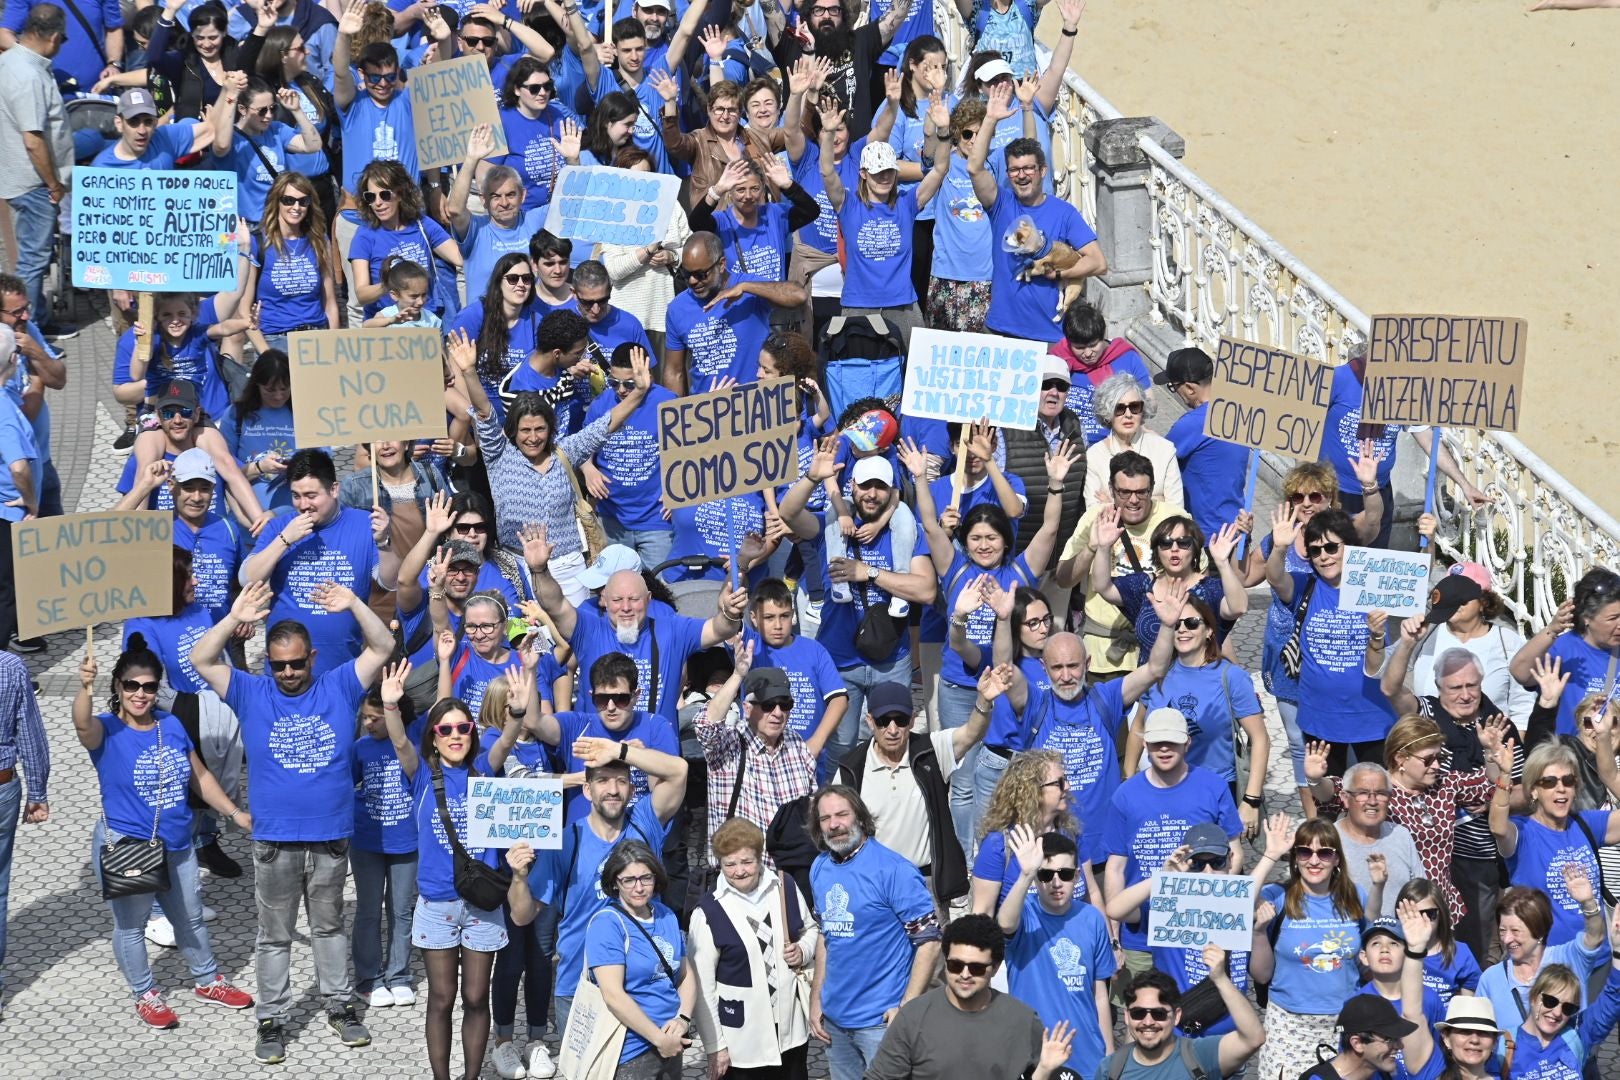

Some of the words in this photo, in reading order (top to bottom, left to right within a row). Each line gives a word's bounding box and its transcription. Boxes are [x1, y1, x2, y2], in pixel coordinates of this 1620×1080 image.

[414, 61, 490, 103] AUTISMOA
[428, 104, 450, 132] EZ
[451, 98, 475, 128] DA
[419, 124, 506, 164] SENDATN
[82, 174, 135, 190] GRACIAS
[142, 177, 152, 190] A
[157, 177, 189, 190] TODO
[194, 178, 234, 190] AQUEL
[82, 196, 105, 208] QUE
[113, 195, 156, 211] ADMITE
[165, 198, 192, 211] QUE
[199, 198, 216, 210] NO
[78, 213, 134, 226] ENTIENDE
[140, 214, 154, 228] DE
[164, 211, 237, 233] AUTISMO
[78, 231, 107, 243] PERO
[112, 231, 138, 245] QUE
[146, 232, 213, 248] DEMUESTRA
[76, 251, 100, 263] QUE
[106, 250, 158, 264] ENTIENDE
[165, 252, 180, 264] DE
[297, 337, 332, 366] EL
[335, 335, 438, 363] AUTISMO
[1370, 317, 1519, 366] ERRESPETATU
[930, 344, 1038, 372] HAGAMOS
[340, 370, 385, 397] NO
[914, 366, 1001, 391] VISIBLE
[1010, 374, 1038, 395] LO
[661, 382, 796, 451] RESPETAME
[912, 390, 1038, 426] INVISIBLE
[1437, 377, 1516, 430] BEZALA
[315, 406, 351, 437] SE
[358, 400, 422, 429] CURA
[1210, 398, 1266, 446] COMO
[1275, 414, 1320, 456] SOY
[665, 452, 737, 503] COMO
[743, 434, 793, 485] SOY
[19, 528, 49, 558] EL
[56, 517, 170, 549] AUTISMO
[60, 556, 106, 588] NO
[1347, 550, 1367, 564] EL
[1363, 558, 1428, 577] AUTISMO
[1346, 571, 1368, 586] SE
[1378, 576, 1417, 591] HACE
[36, 597, 68, 625] SE
[79, 585, 147, 618] CURA
[472, 781, 493, 797] EL
[491, 788, 562, 805] AUTISMO
[475, 804, 495, 820] SE
[508, 806, 552, 821] HACE
[1151, 896, 1178, 912] ERE
[1166, 909, 1246, 931] AUTISMOA
[1154, 926, 1208, 945] DUGU
